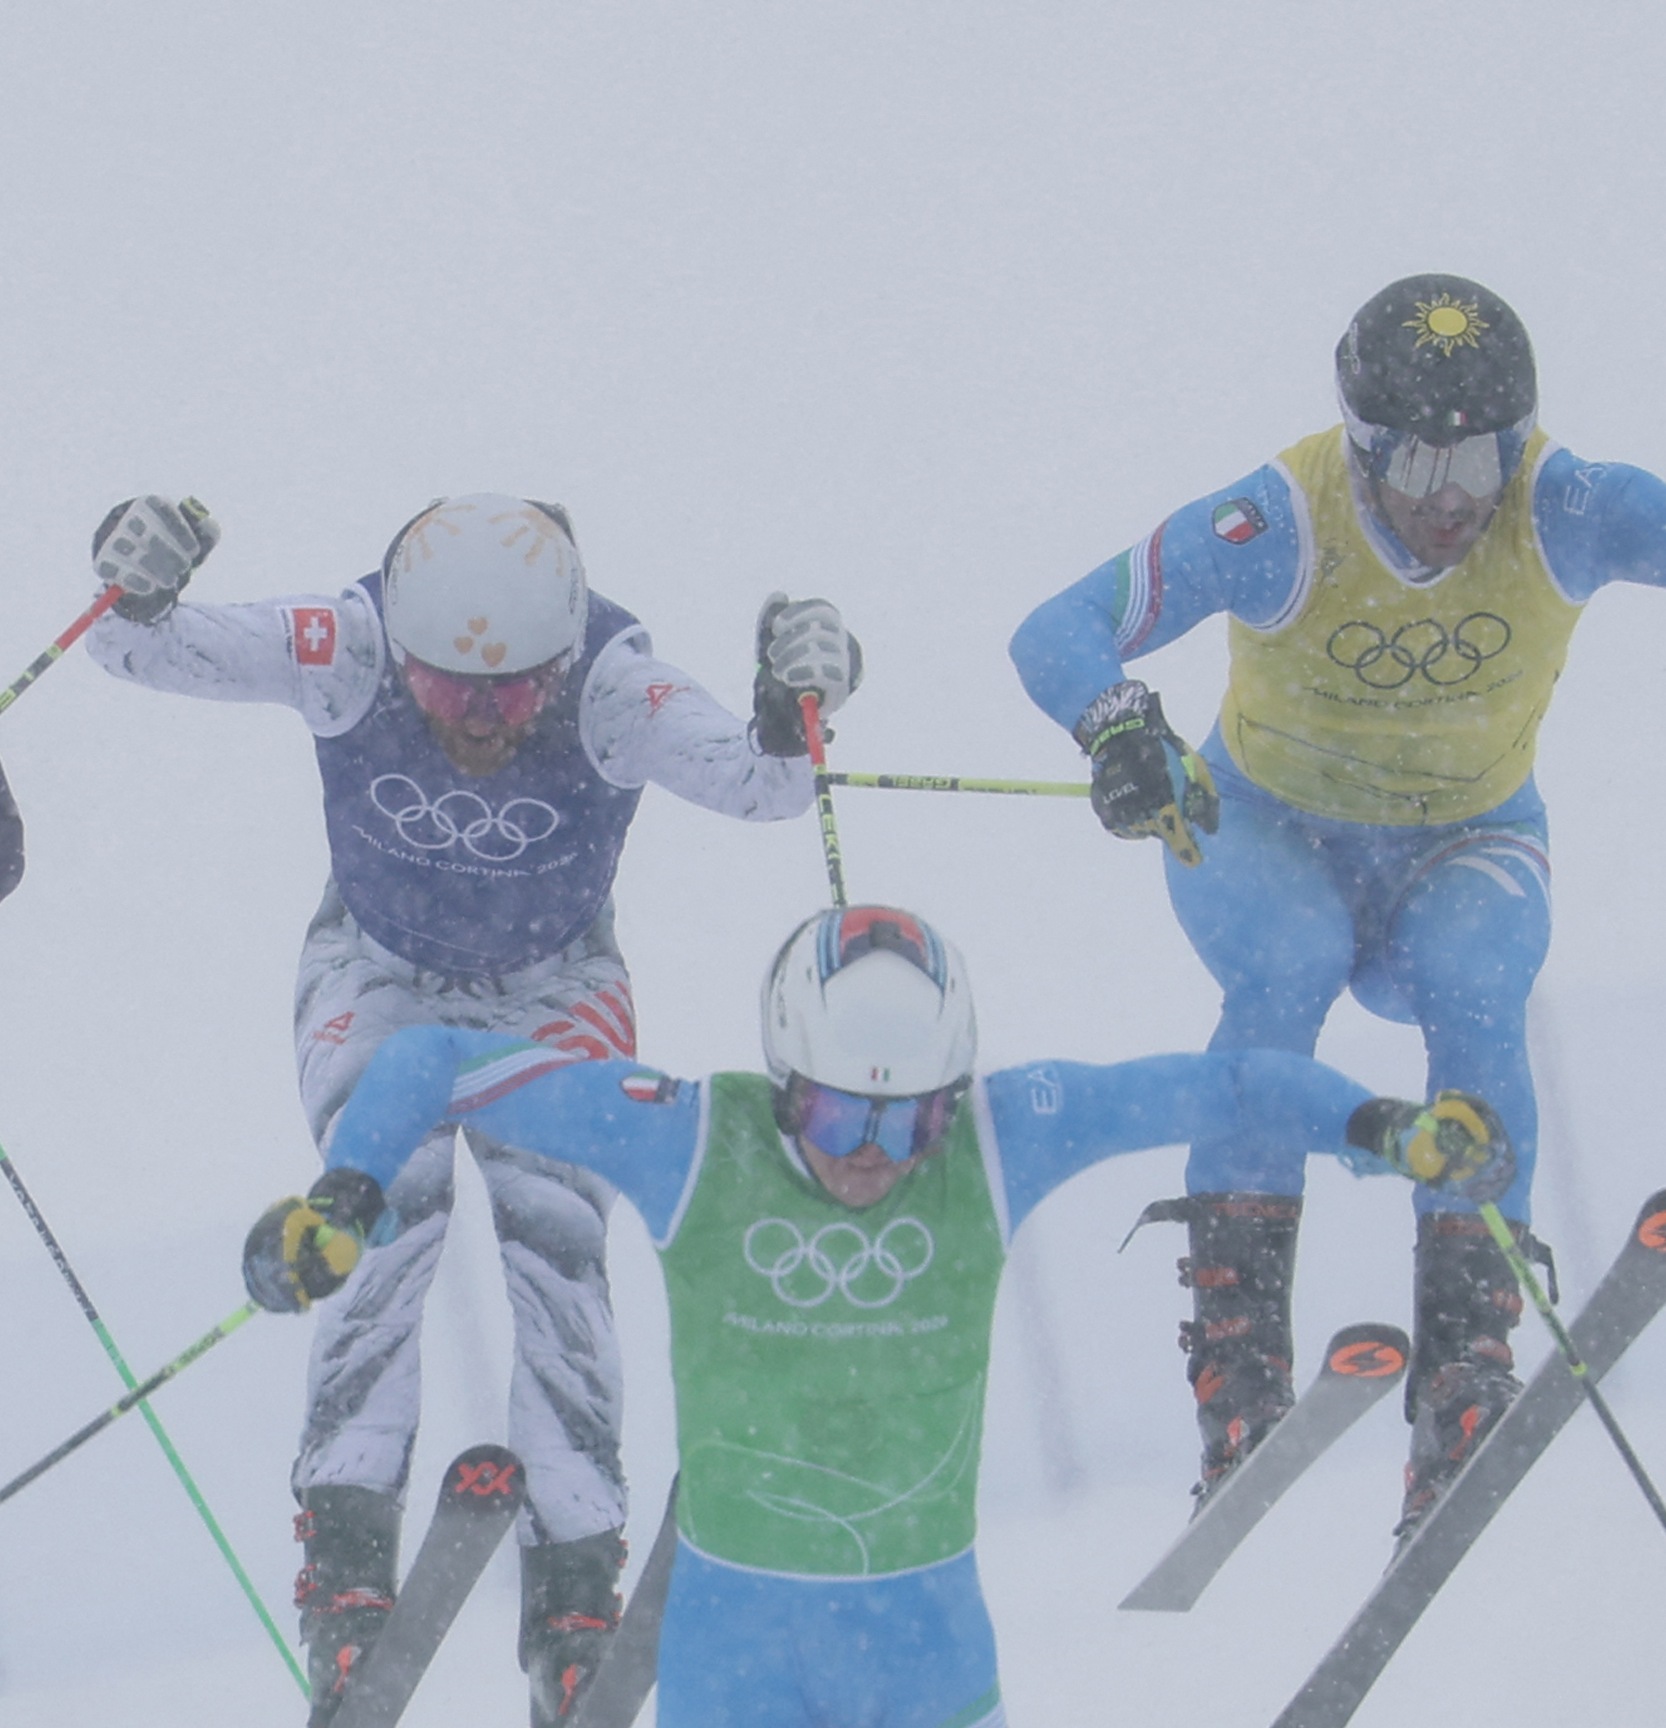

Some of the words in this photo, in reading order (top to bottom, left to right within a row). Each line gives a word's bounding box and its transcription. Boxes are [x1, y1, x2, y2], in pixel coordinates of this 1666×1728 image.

[350, 824, 431, 867] MILANO
[434, 860, 533, 878] CORTINA
[722, 1312, 809, 1338] MILANO
[810, 1320, 904, 1339] CORTINA
[910, 1314, 950, 1334] 2026
